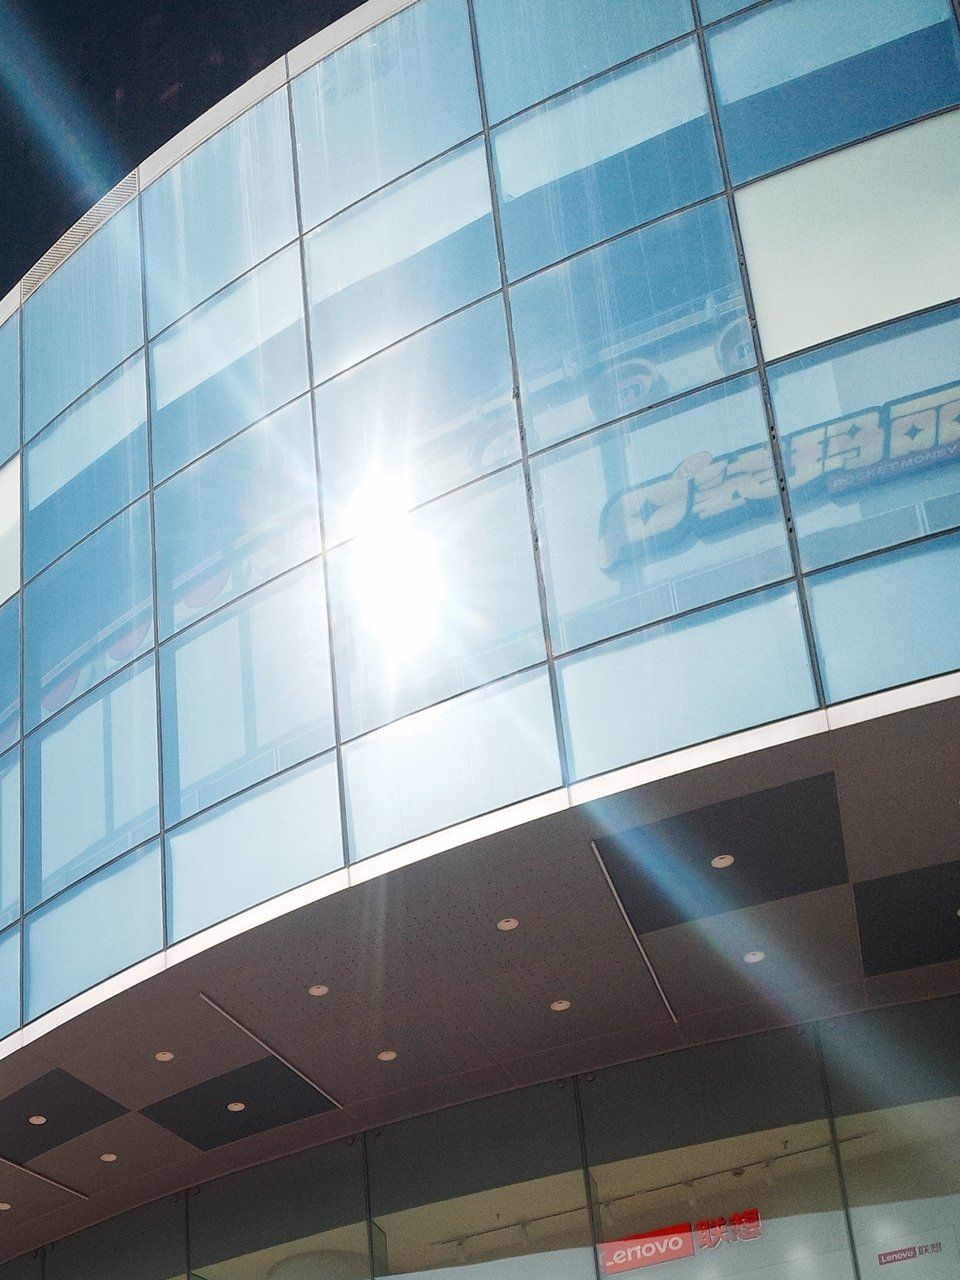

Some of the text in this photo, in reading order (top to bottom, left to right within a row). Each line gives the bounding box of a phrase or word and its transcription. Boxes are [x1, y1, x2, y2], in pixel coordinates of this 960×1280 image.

[605, 1236, 683, 1267] enovo
[881, 1241, 943, 1264] Lenovo 联想
